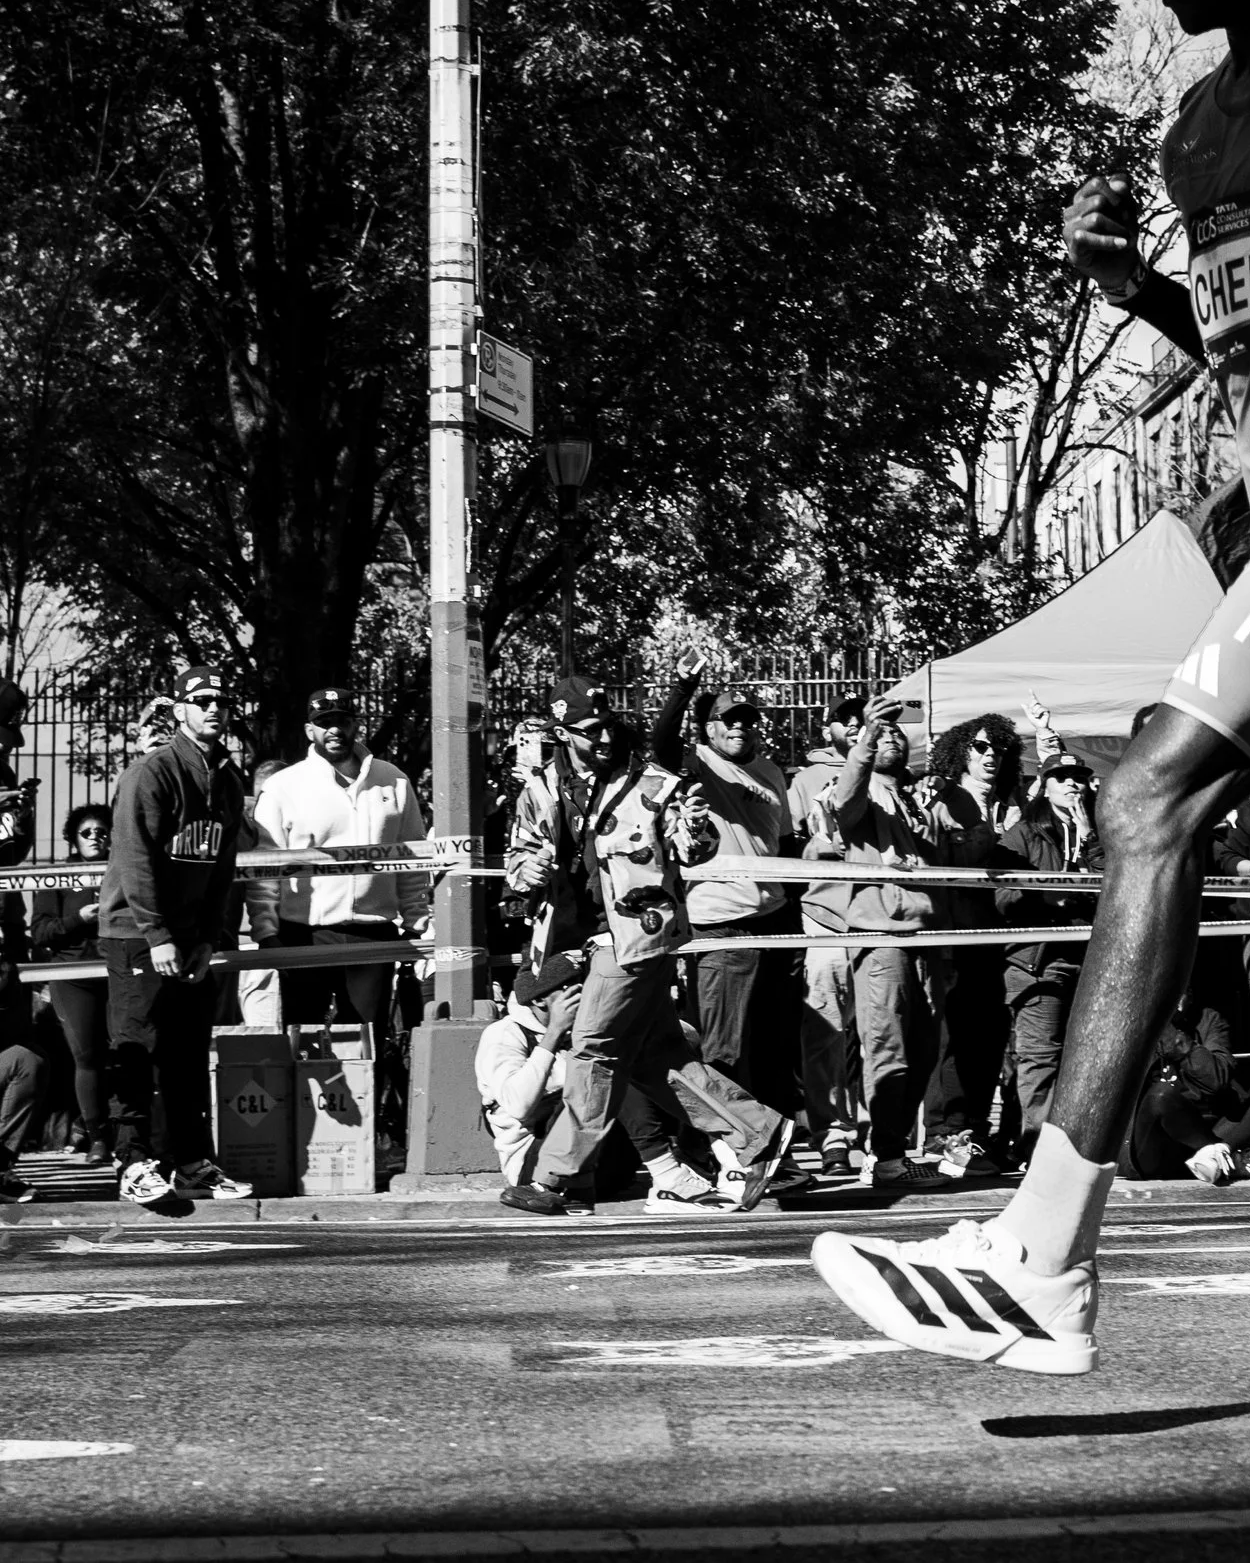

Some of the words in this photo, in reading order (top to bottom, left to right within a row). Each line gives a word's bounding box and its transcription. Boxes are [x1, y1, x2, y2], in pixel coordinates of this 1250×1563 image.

[1215, 201, 1238, 215] TATA
[1217, 218, 1250, 235] SERVICES
[312, 863, 352, 875] NEW
[0, 876, 26, 889] EW
[32, 874, 84, 888] YORK
[237, 1094, 269, 1114] C&L
[317, 1093, 347, 1112] C&L
